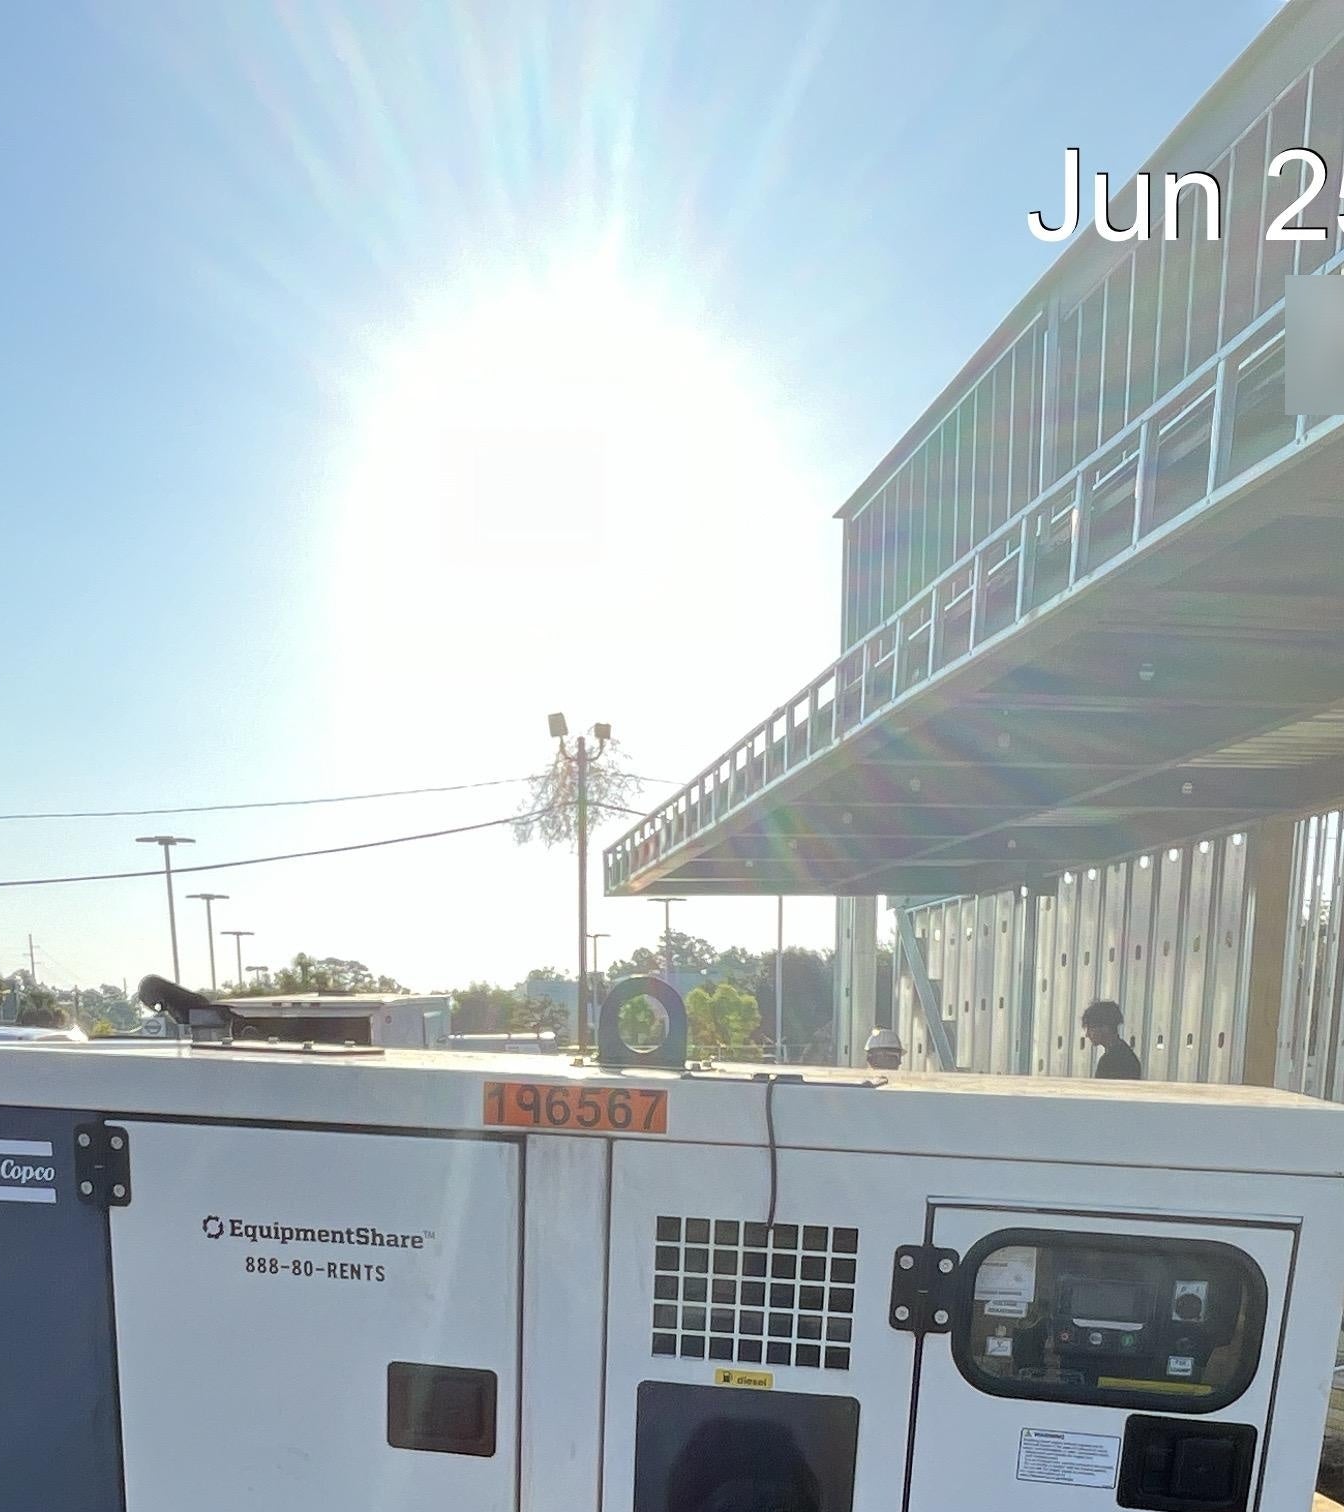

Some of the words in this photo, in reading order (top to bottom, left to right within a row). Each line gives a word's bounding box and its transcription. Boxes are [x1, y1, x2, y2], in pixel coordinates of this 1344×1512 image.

[487, 1082, 665, 1130] 196567
[0, 1159, 55, 1184] Copco
[245, 1256, 386, 1282] 888-80-RENTS
[737, 1375, 768, 1387] diesel
